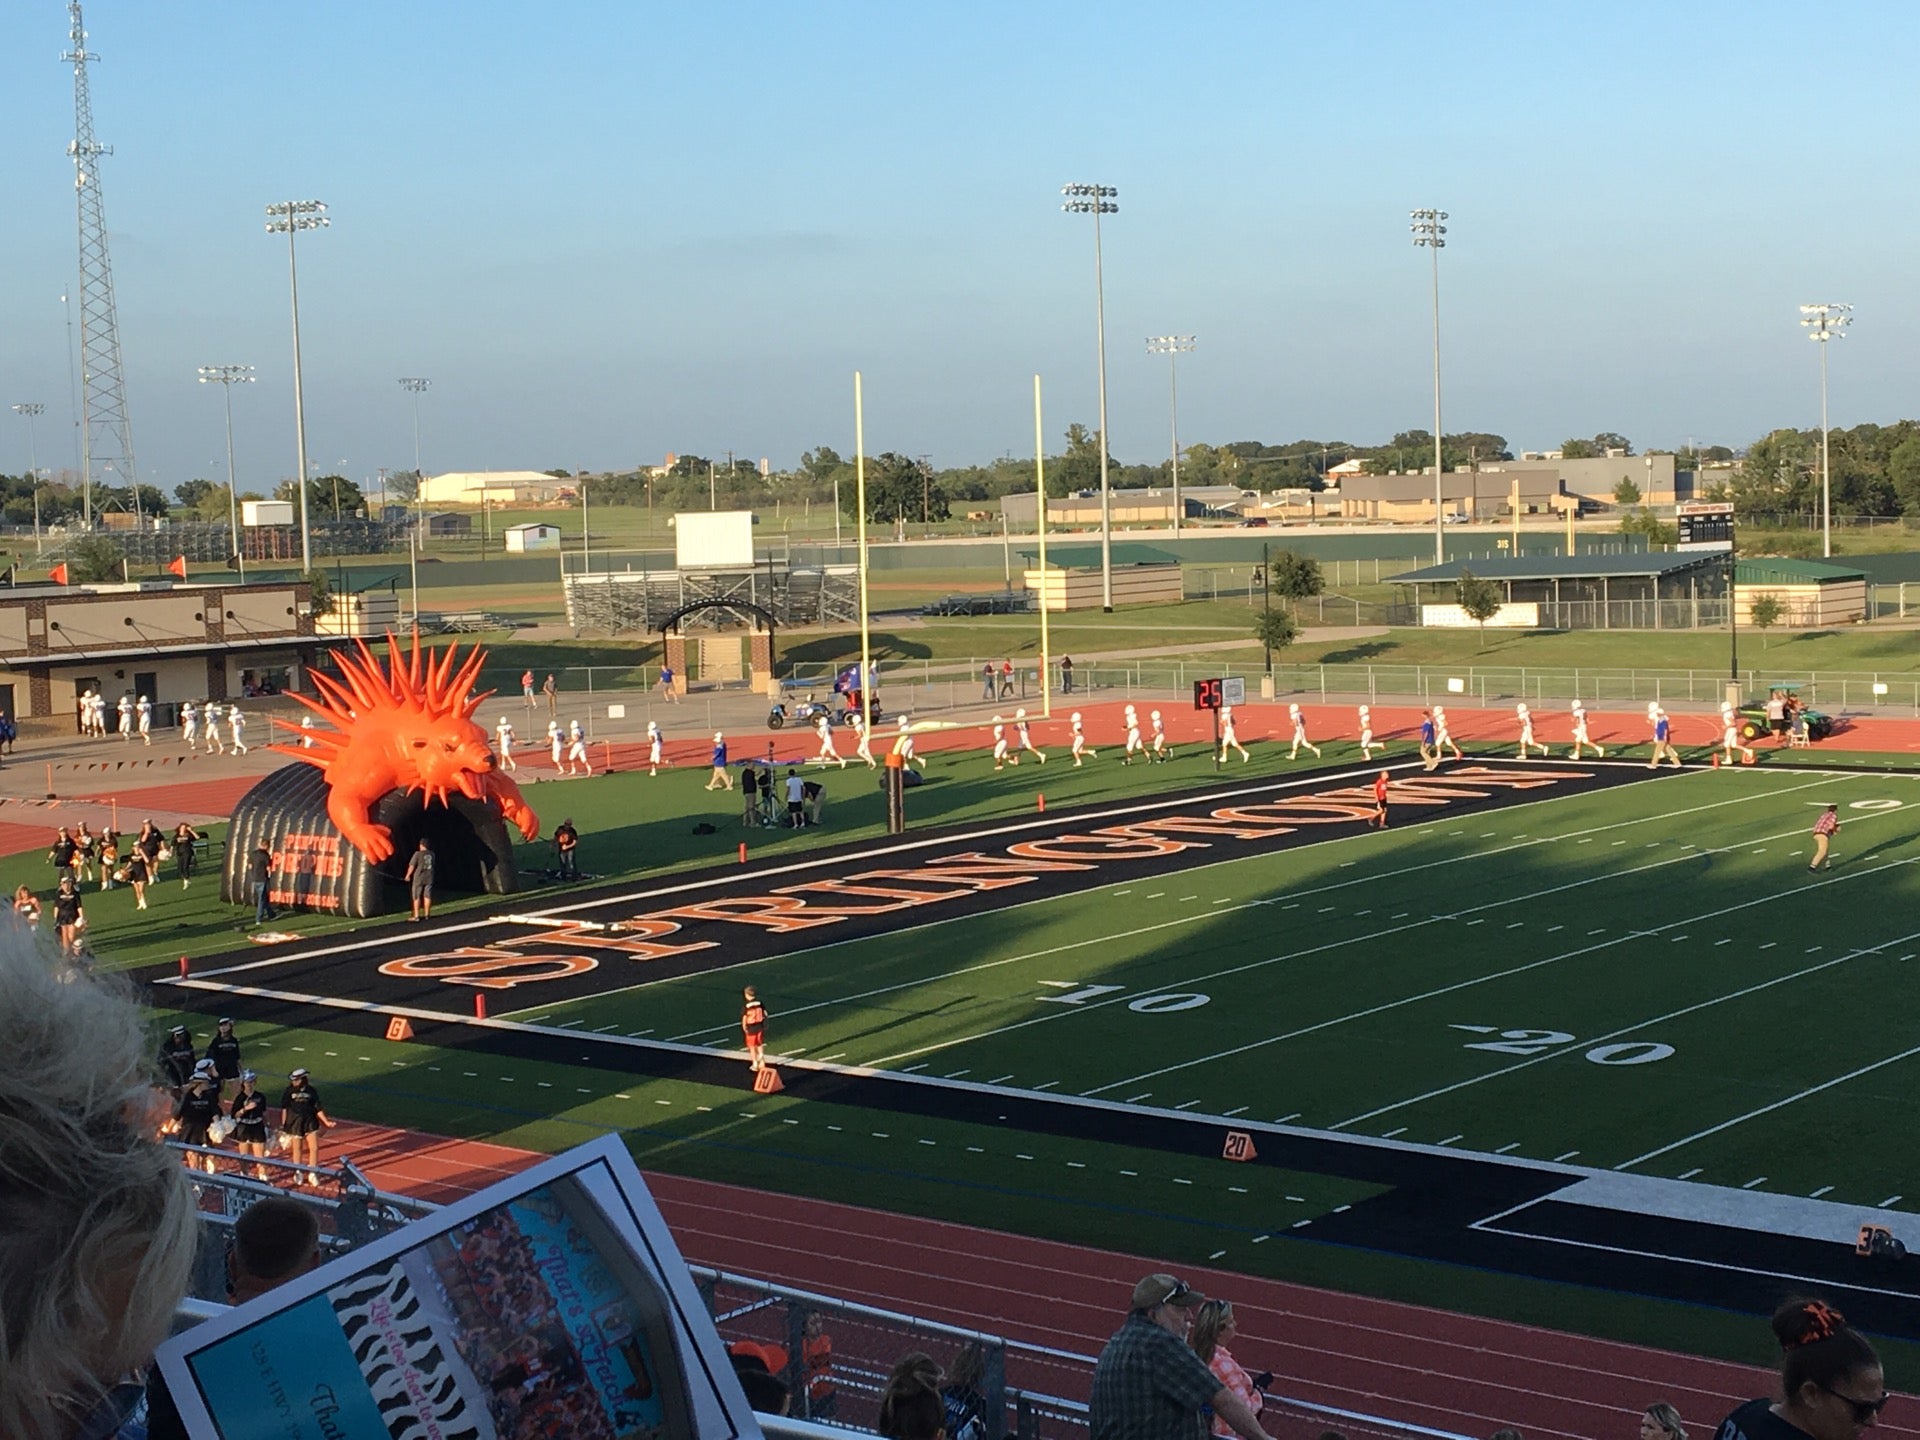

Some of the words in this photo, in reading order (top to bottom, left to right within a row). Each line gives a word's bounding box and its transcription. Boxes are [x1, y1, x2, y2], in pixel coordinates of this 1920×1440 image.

[1200, 681, 1221, 707] 25
[377, 766, 1596, 990] SPRINGTOWN
[390, 1020, 402, 1037] G
[1463, 1029, 1676, 1065] 20
[757, 1070, 773, 1090] 10
[1225, 1135, 1247, 1157] 20
[404, 1368, 428, 1406] short
